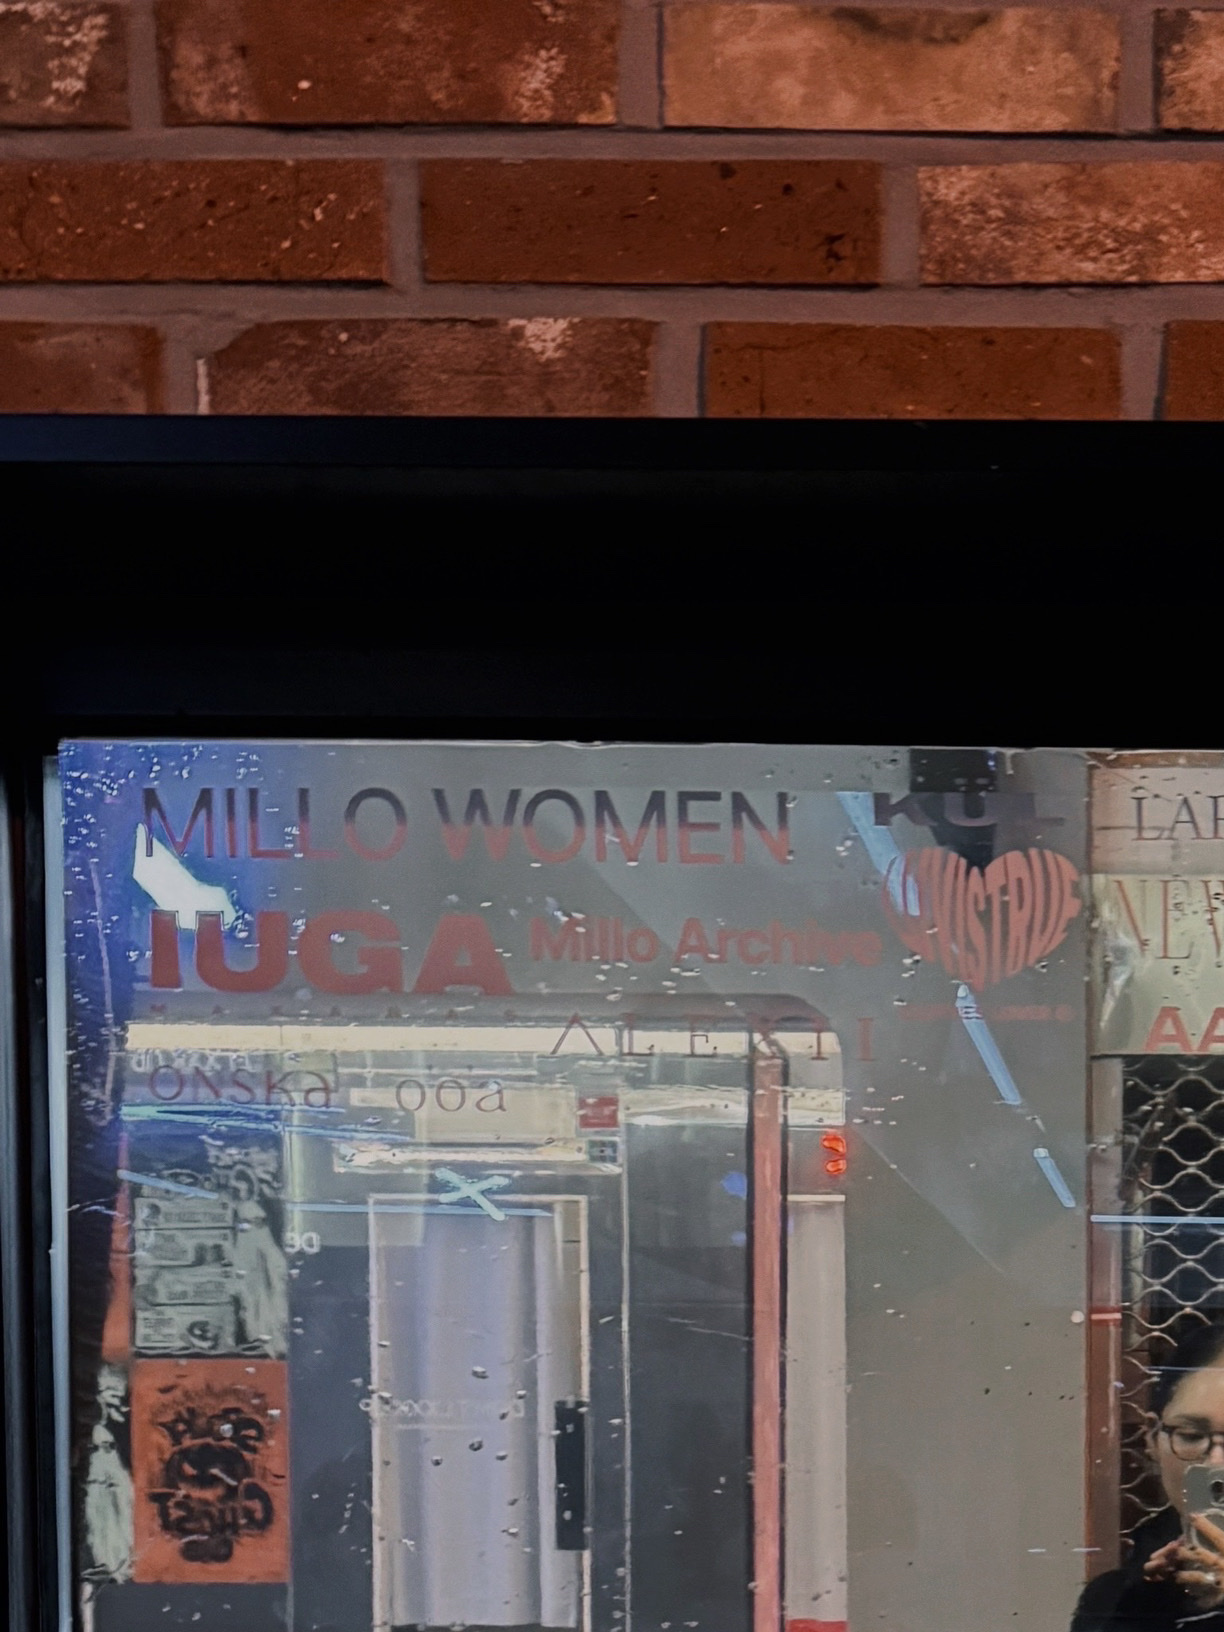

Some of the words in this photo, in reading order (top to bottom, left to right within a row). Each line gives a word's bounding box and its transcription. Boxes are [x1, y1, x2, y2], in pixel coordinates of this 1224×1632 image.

[142, 787, 408, 862] MILLO
[431, 788, 791, 864] WOMEN
[673, 916, 884, 967] Archive
